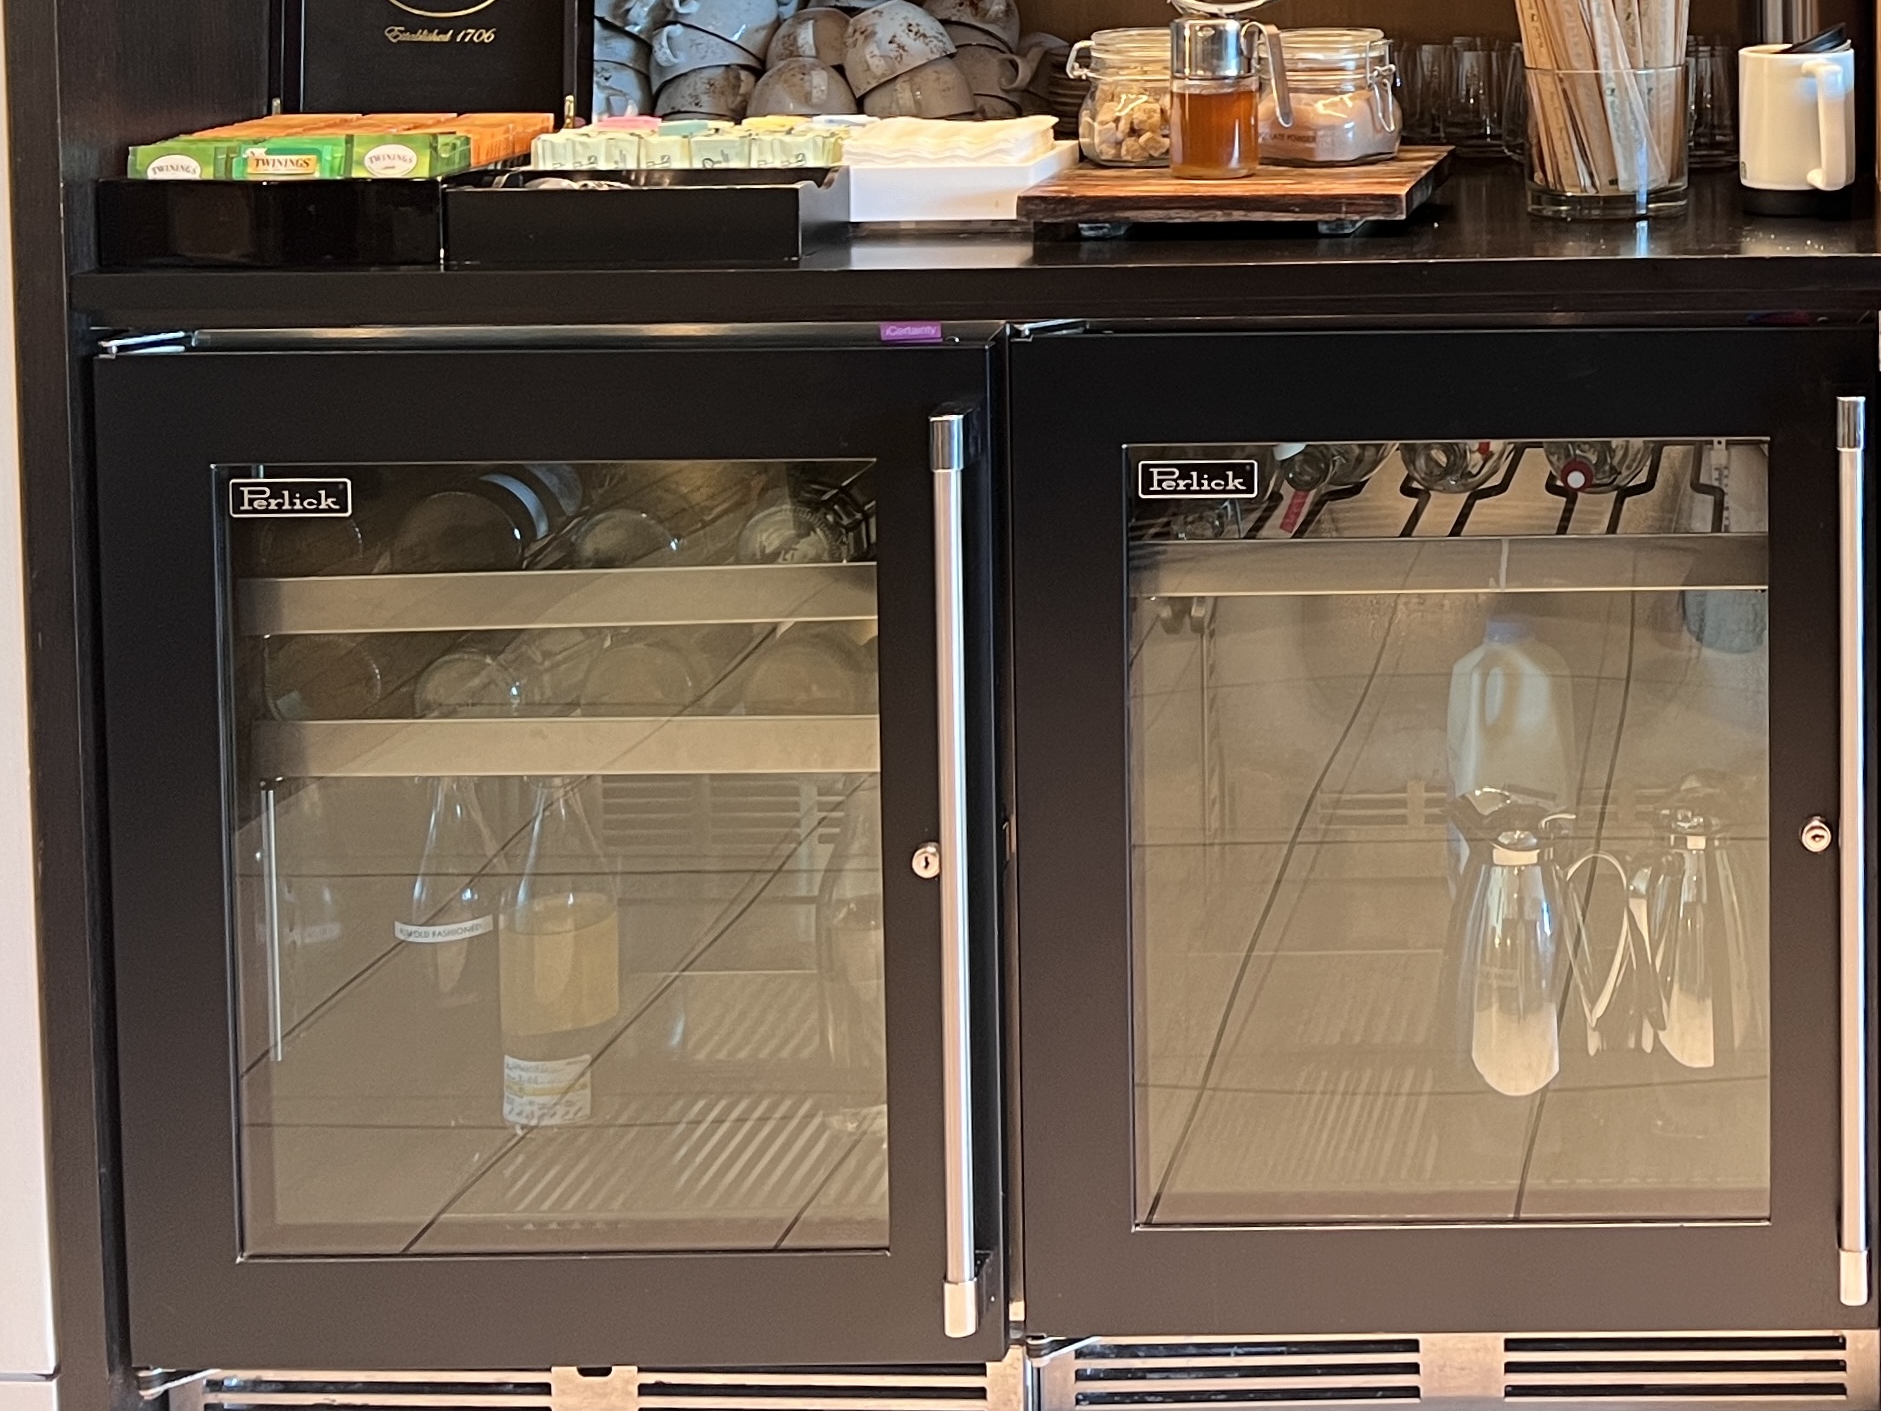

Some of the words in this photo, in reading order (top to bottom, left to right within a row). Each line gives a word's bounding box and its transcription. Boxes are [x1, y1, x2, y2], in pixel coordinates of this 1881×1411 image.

[384, 26, 453, 43] Established
[456, 27, 497, 43] 1706
[254, 157, 312, 168] TWININGS
[368, 154, 413, 164] TWININGS
[151, 164, 197, 176] TWININGS
[1149, 467, 1247, 490] Perlick
[239, 486, 341, 510] Perlick
